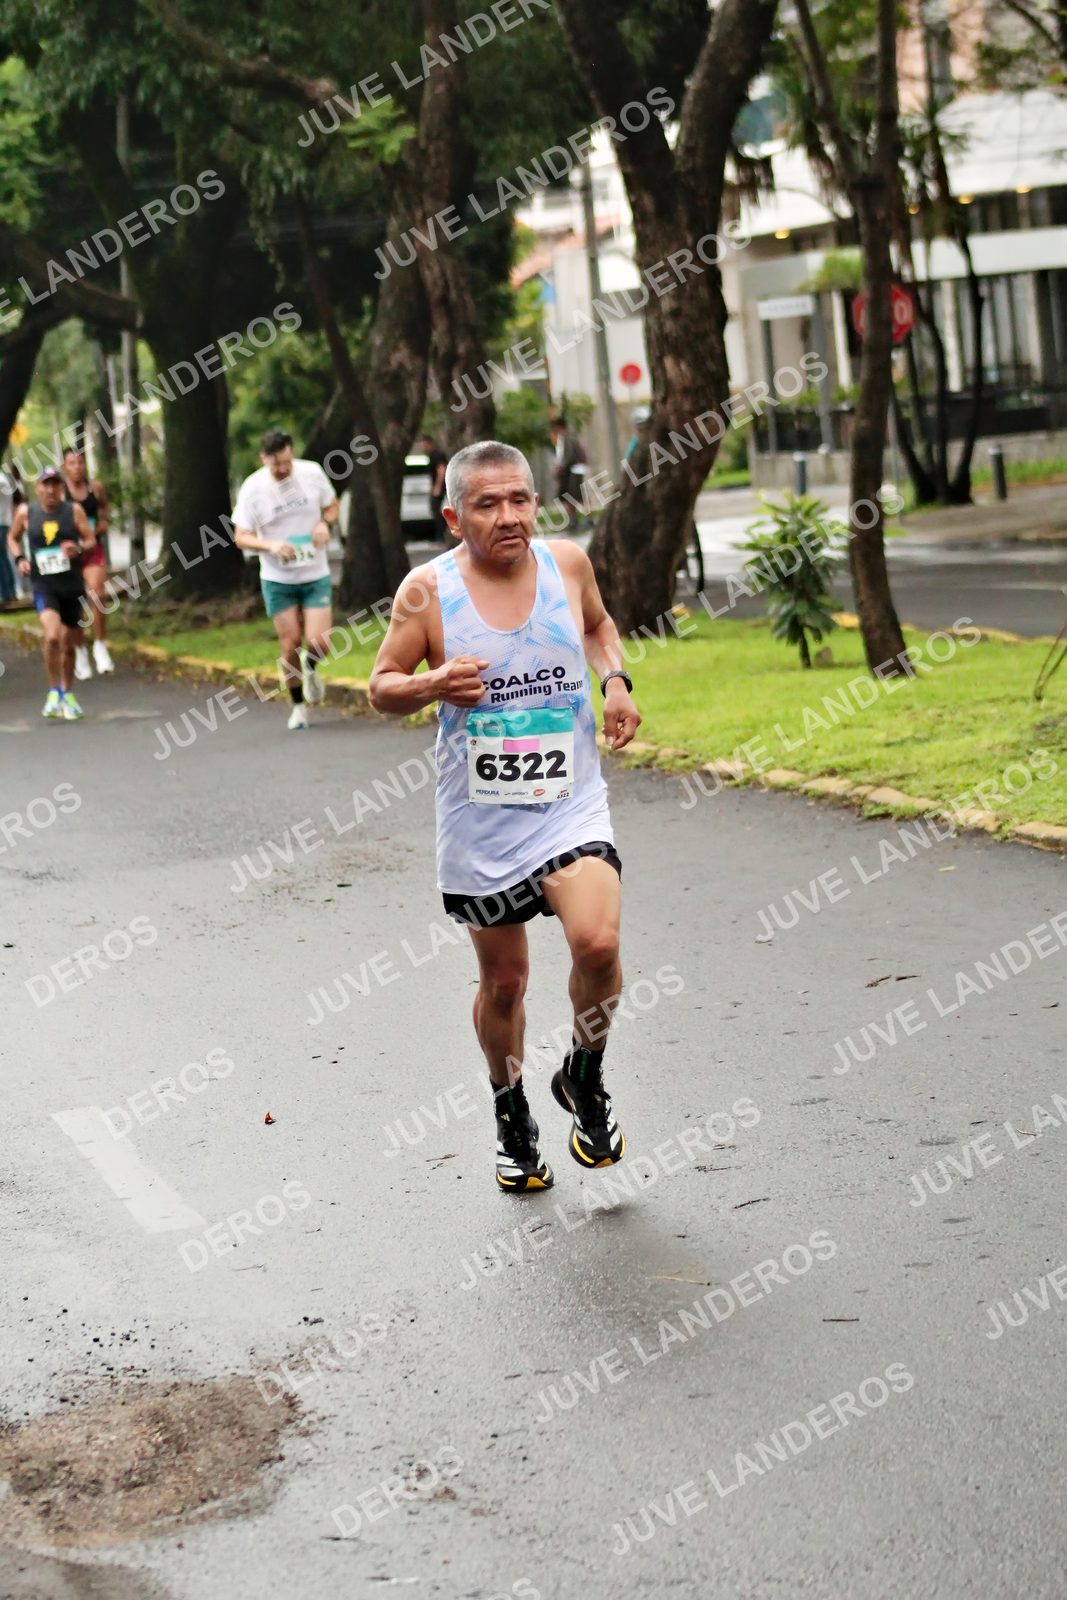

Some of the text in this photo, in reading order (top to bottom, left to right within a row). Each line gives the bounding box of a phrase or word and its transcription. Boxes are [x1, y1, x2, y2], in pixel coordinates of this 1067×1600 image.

[491, 680, 583, 703] Running Team
[476, 750, 567, 781] 6322
